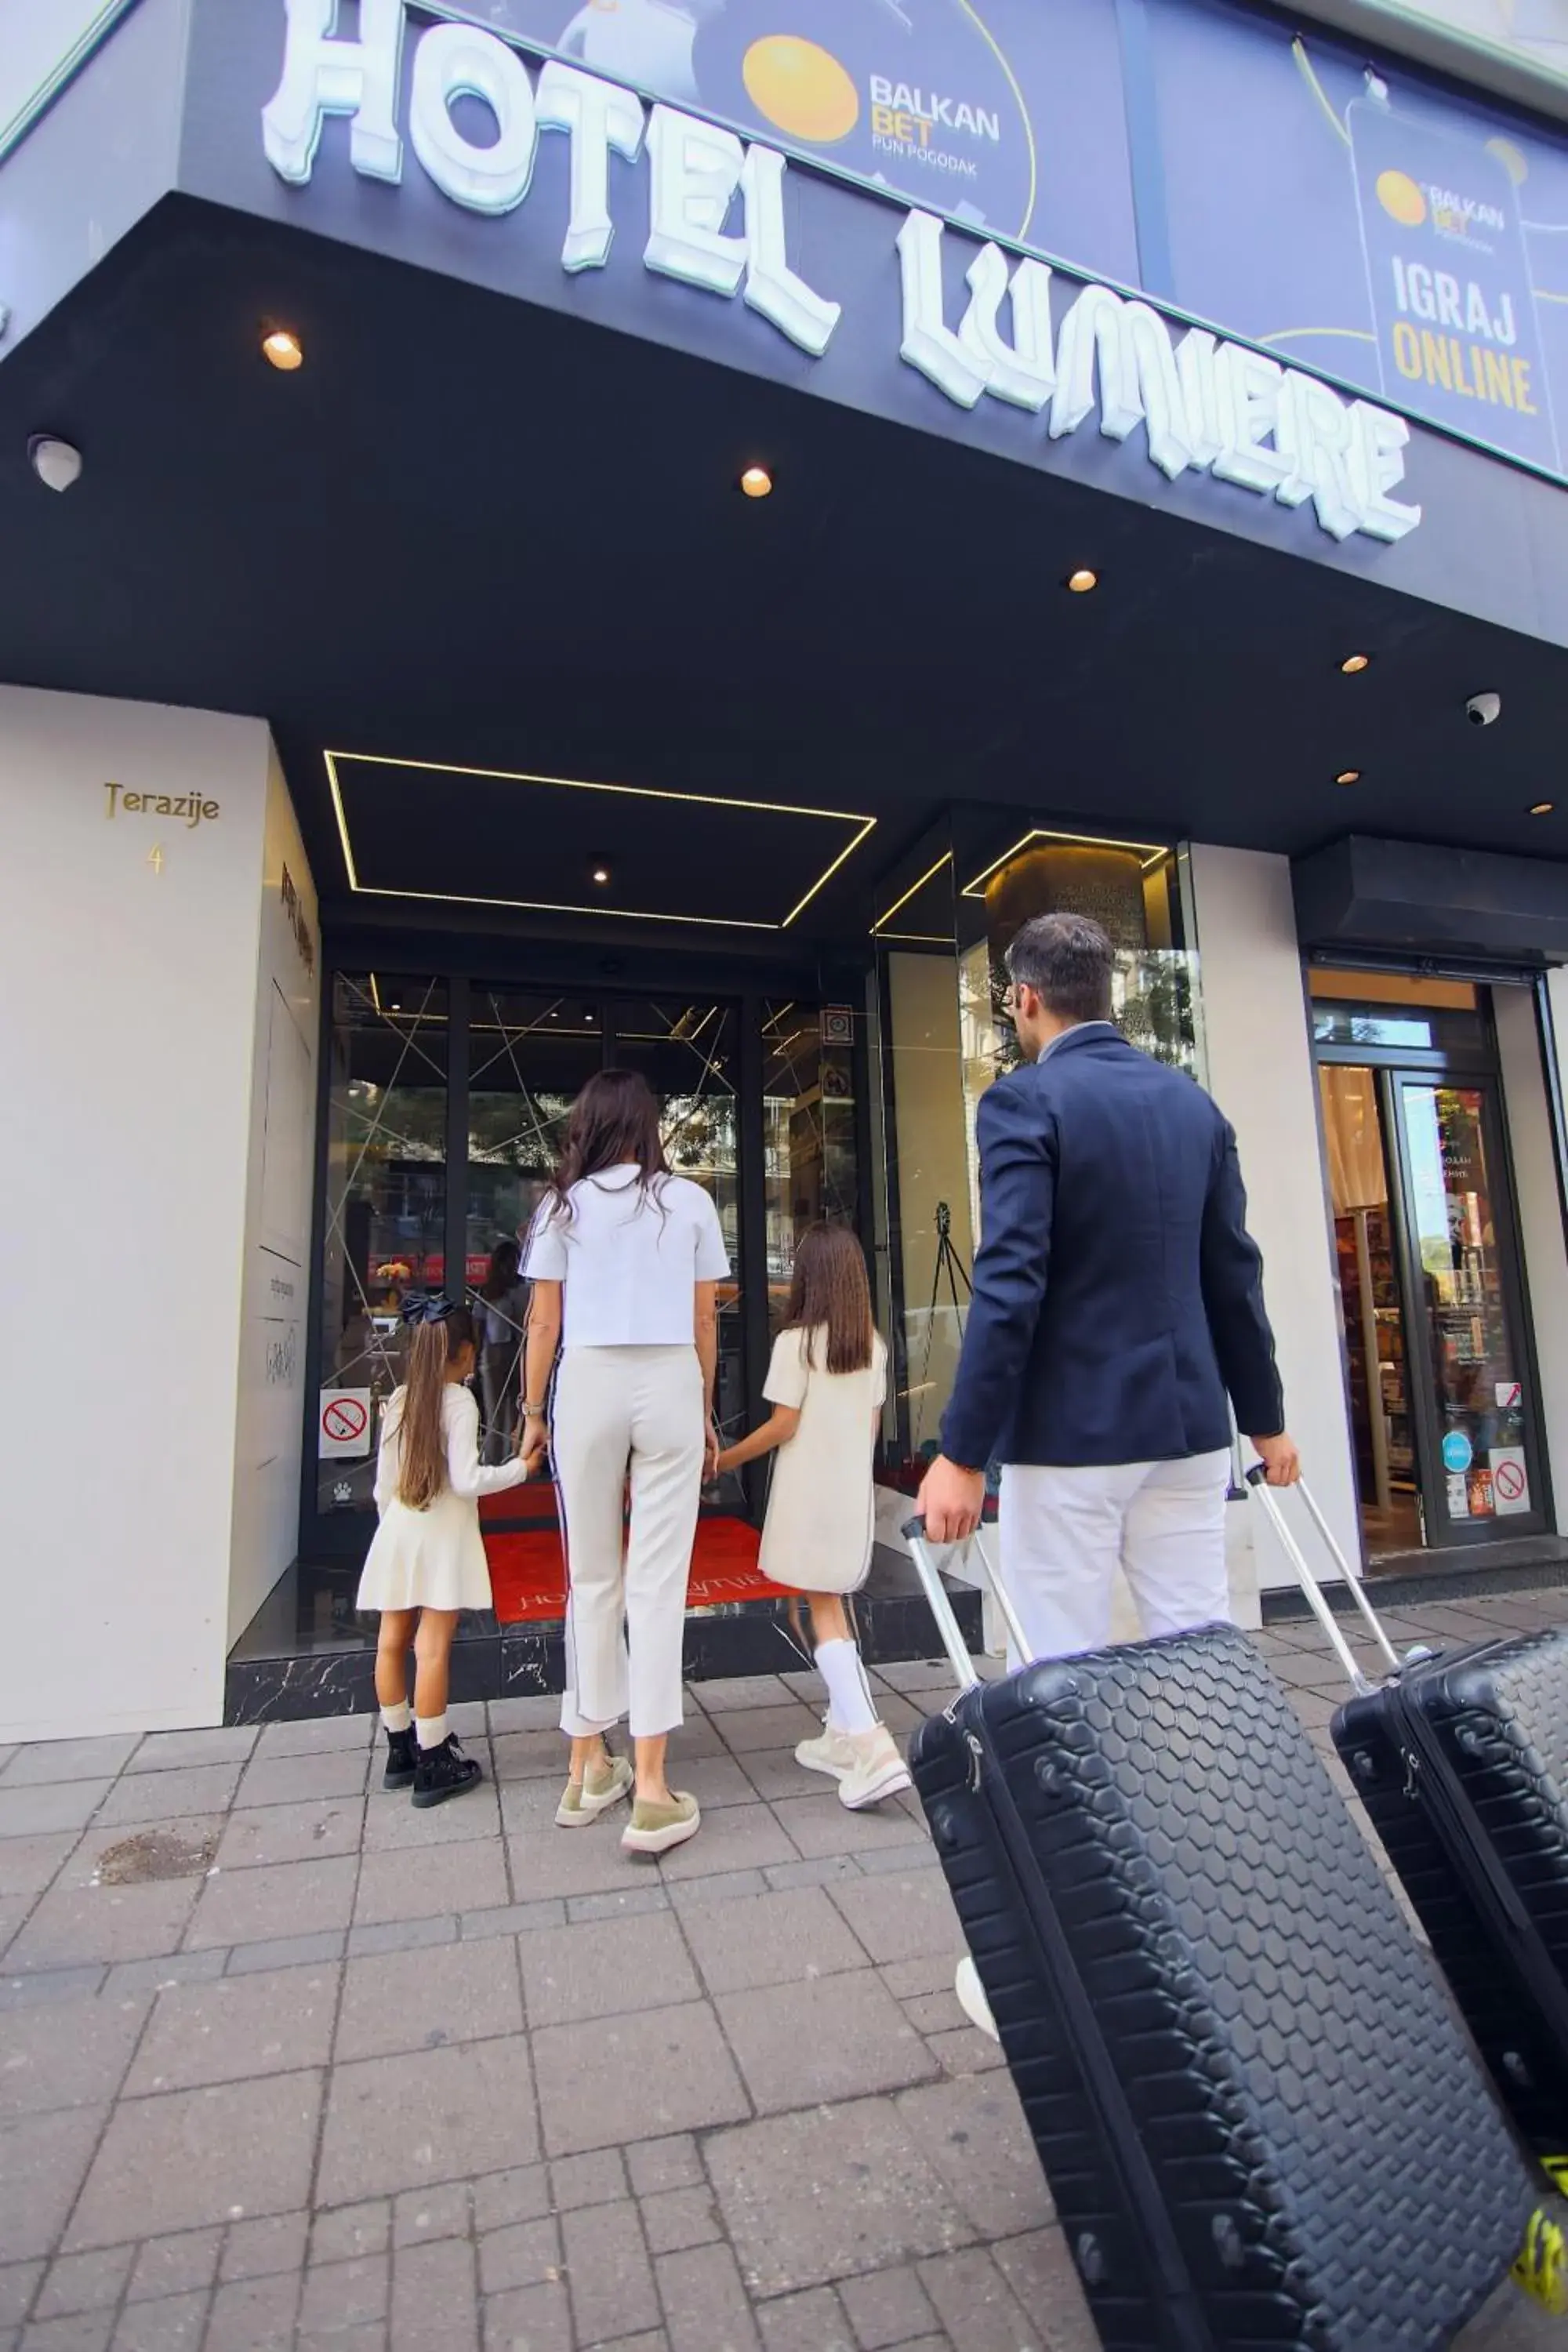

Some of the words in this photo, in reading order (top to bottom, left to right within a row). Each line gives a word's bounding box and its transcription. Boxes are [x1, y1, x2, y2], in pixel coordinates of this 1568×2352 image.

[869, 74, 1000, 141] BALKAN
[872, 103, 933, 147] BET
[872, 133, 904, 154] PUN
[262, 0, 841, 358] HOTEL
[895, 207, 1421, 543] LUMIERE
[1392, 255, 1516, 346] IGRAJ
[1393, 321, 1538, 415] ONLINE
[104, 782, 220, 829] Terazije
[147, 842, 164, 875] 4
